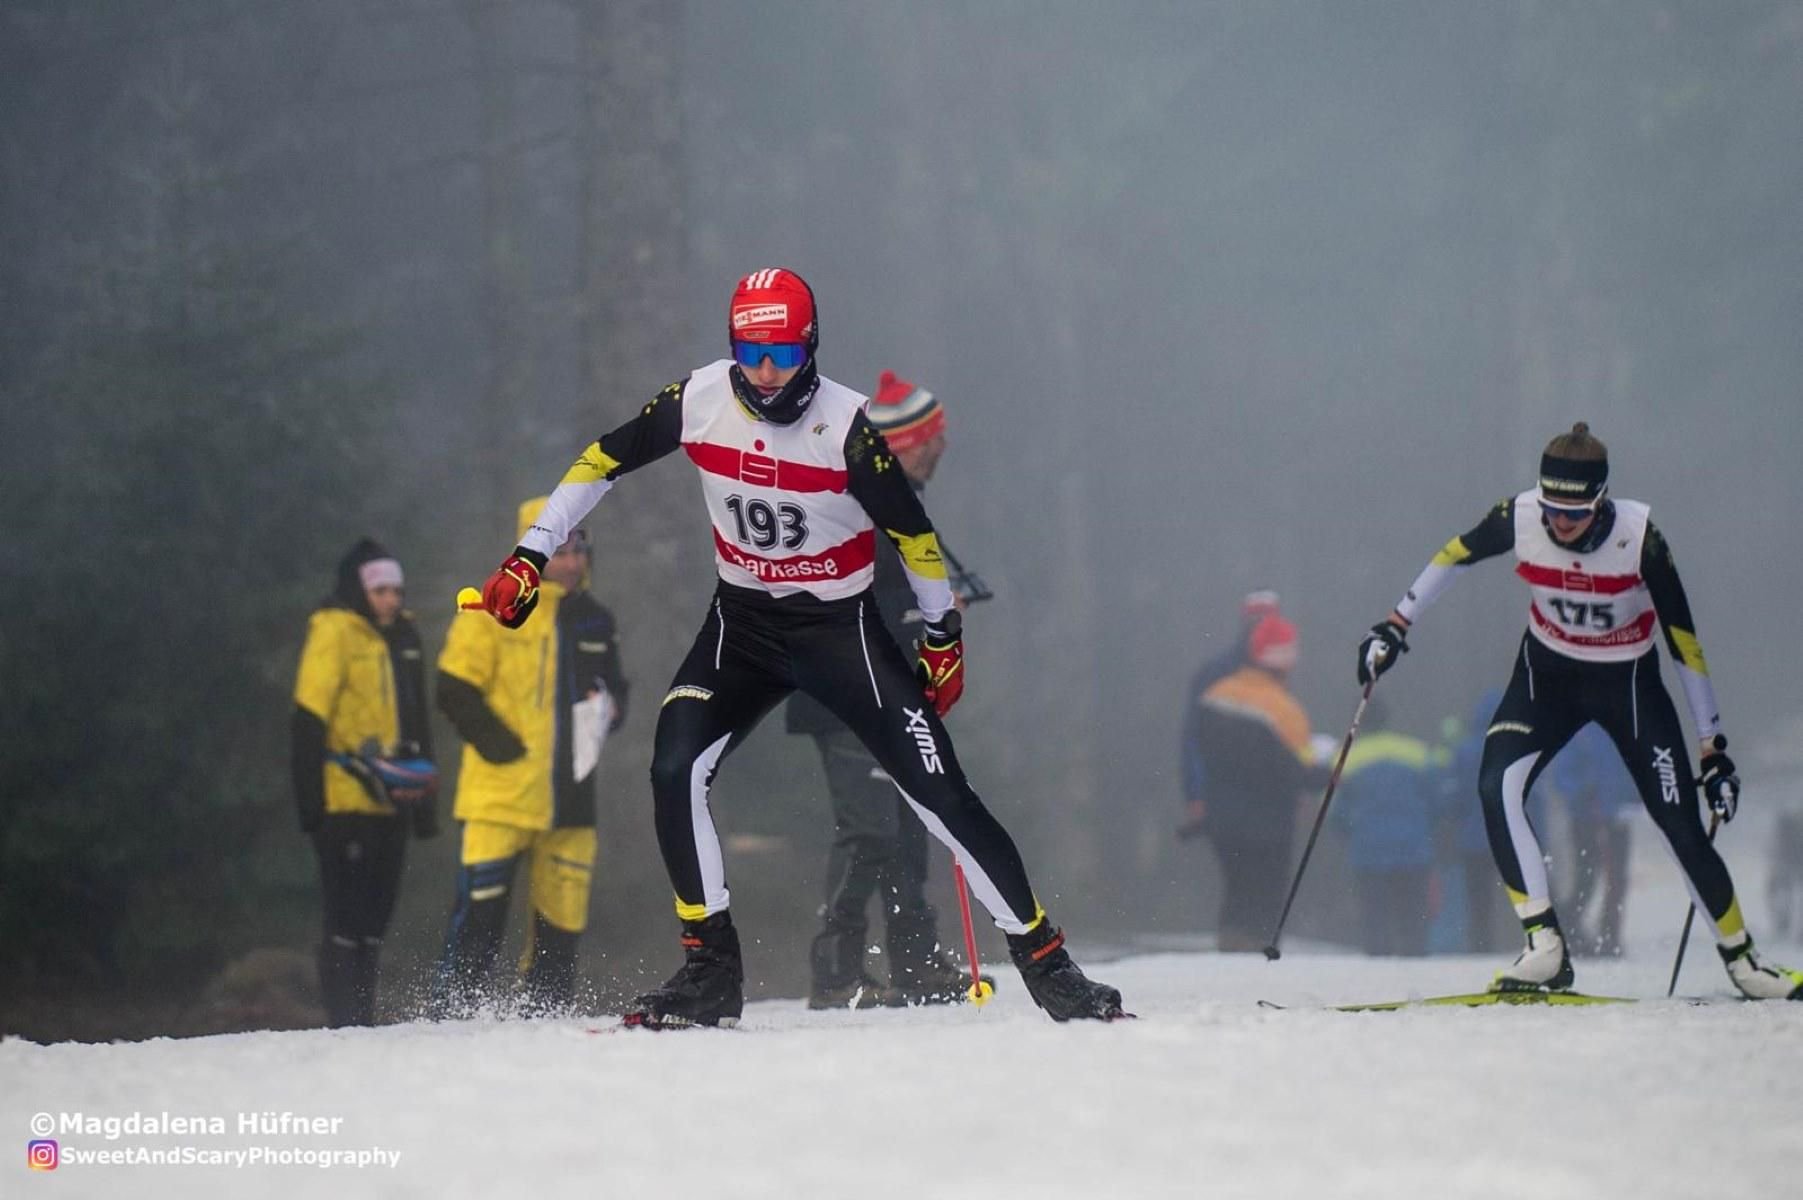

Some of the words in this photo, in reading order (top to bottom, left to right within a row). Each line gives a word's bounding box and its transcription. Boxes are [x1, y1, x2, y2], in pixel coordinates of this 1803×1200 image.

[724, 493, 810, 551] 193
[726, 545, 838, 578] parkasse
[1548, 597, 1615, 630] 175
